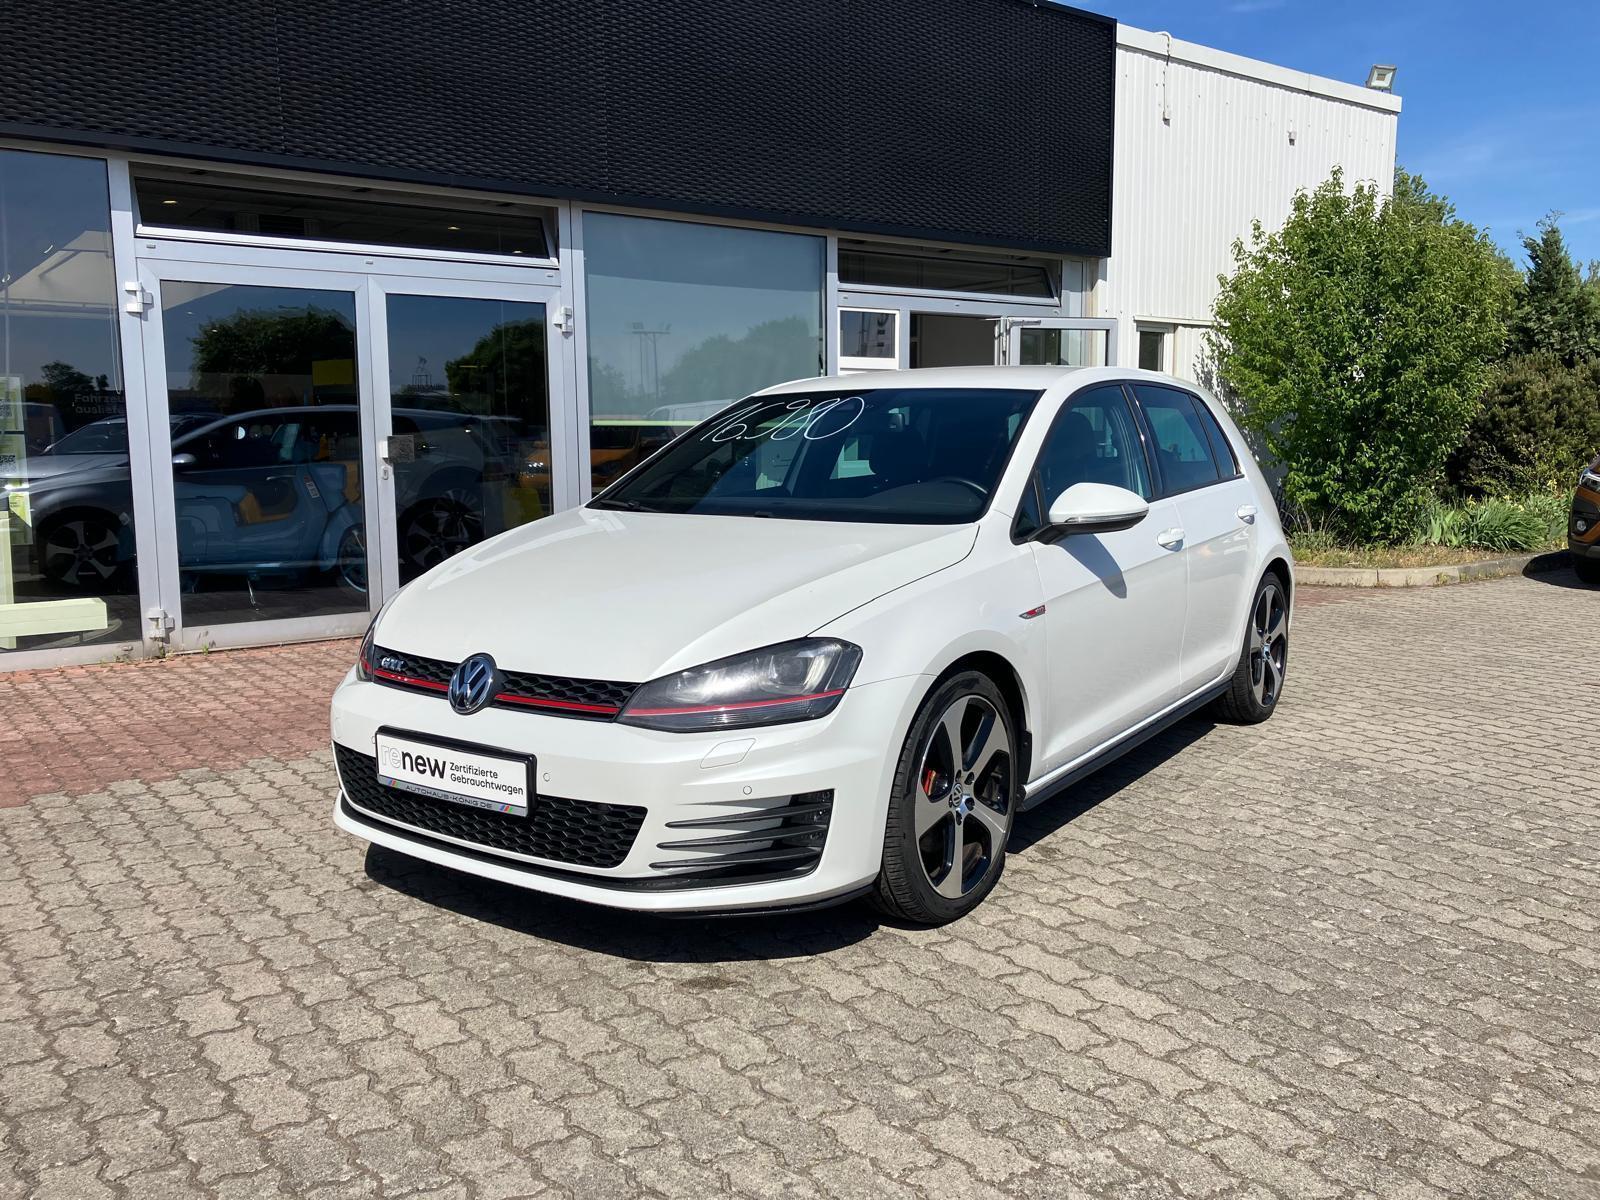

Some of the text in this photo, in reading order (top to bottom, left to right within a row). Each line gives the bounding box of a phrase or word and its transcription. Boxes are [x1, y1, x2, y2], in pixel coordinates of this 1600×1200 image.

[381, 656, 405, 672] GTI
[380, 744, 447, 779] renew
[449, 762, 499, 779] Zertifizierte
[450, 774, 524, 796] Gebrauchtwagen
[405, 785, 493, 809] AUTOHAUS-KÖNIG.DE
